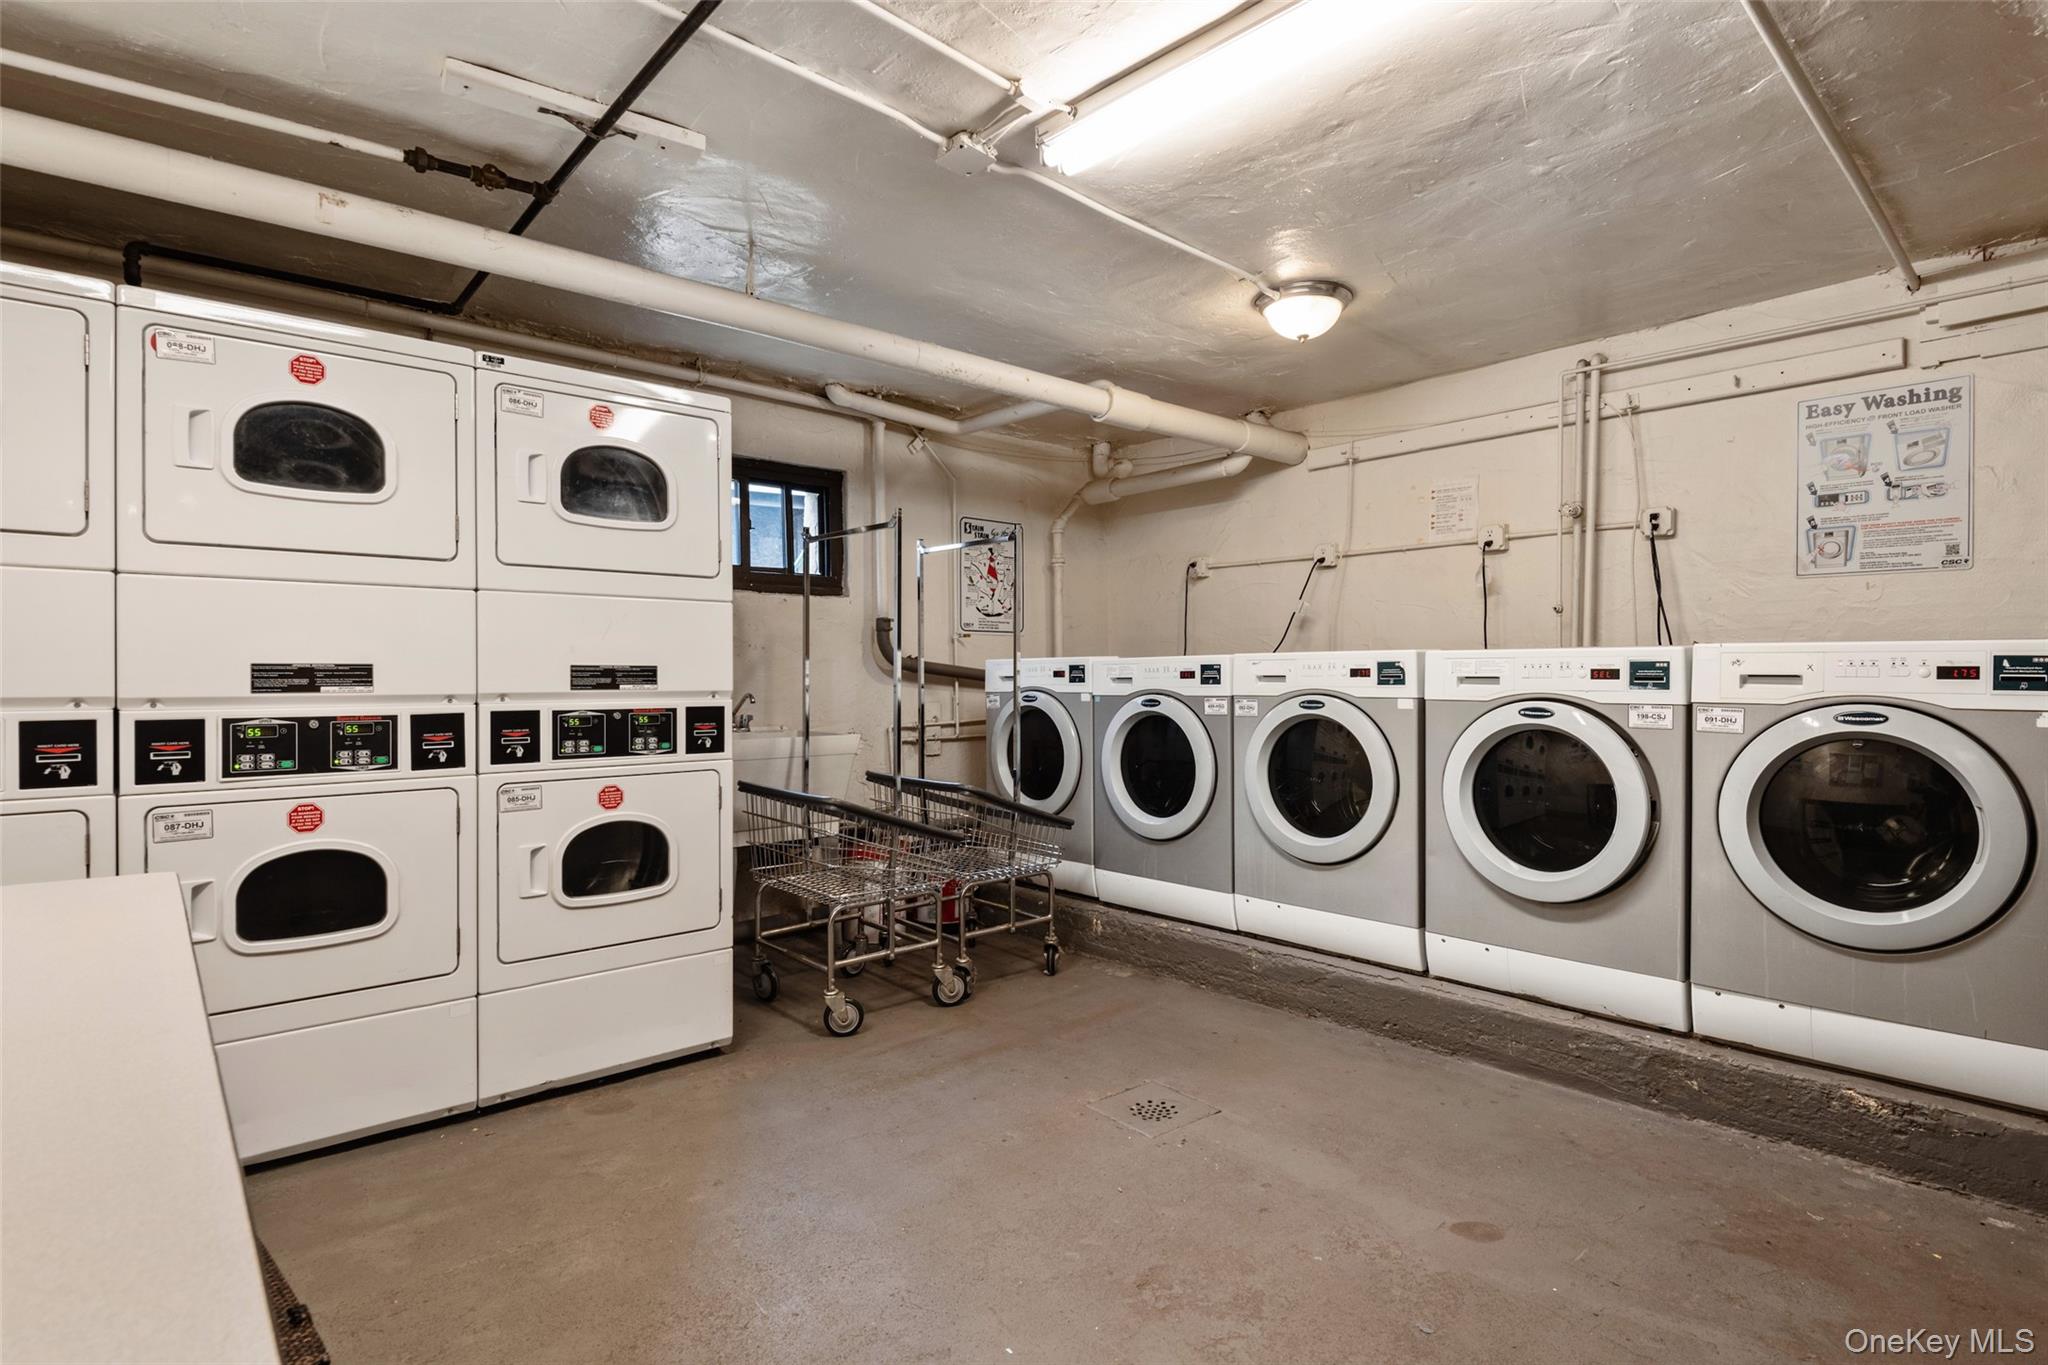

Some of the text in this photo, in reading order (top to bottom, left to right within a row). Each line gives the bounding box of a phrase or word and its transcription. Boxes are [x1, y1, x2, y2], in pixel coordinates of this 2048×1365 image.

[1806, 386, 1963, 419] Easy Washing
[1878, 412, 1902, 420] FRONT
[1905, 408, 1927, 417] LOAD
[1928, 403, 1962, 413] WASHER
[1704, 716, 1737, 724] 091-DHJ
[163, 821, 204, 831] 087-DHJ
